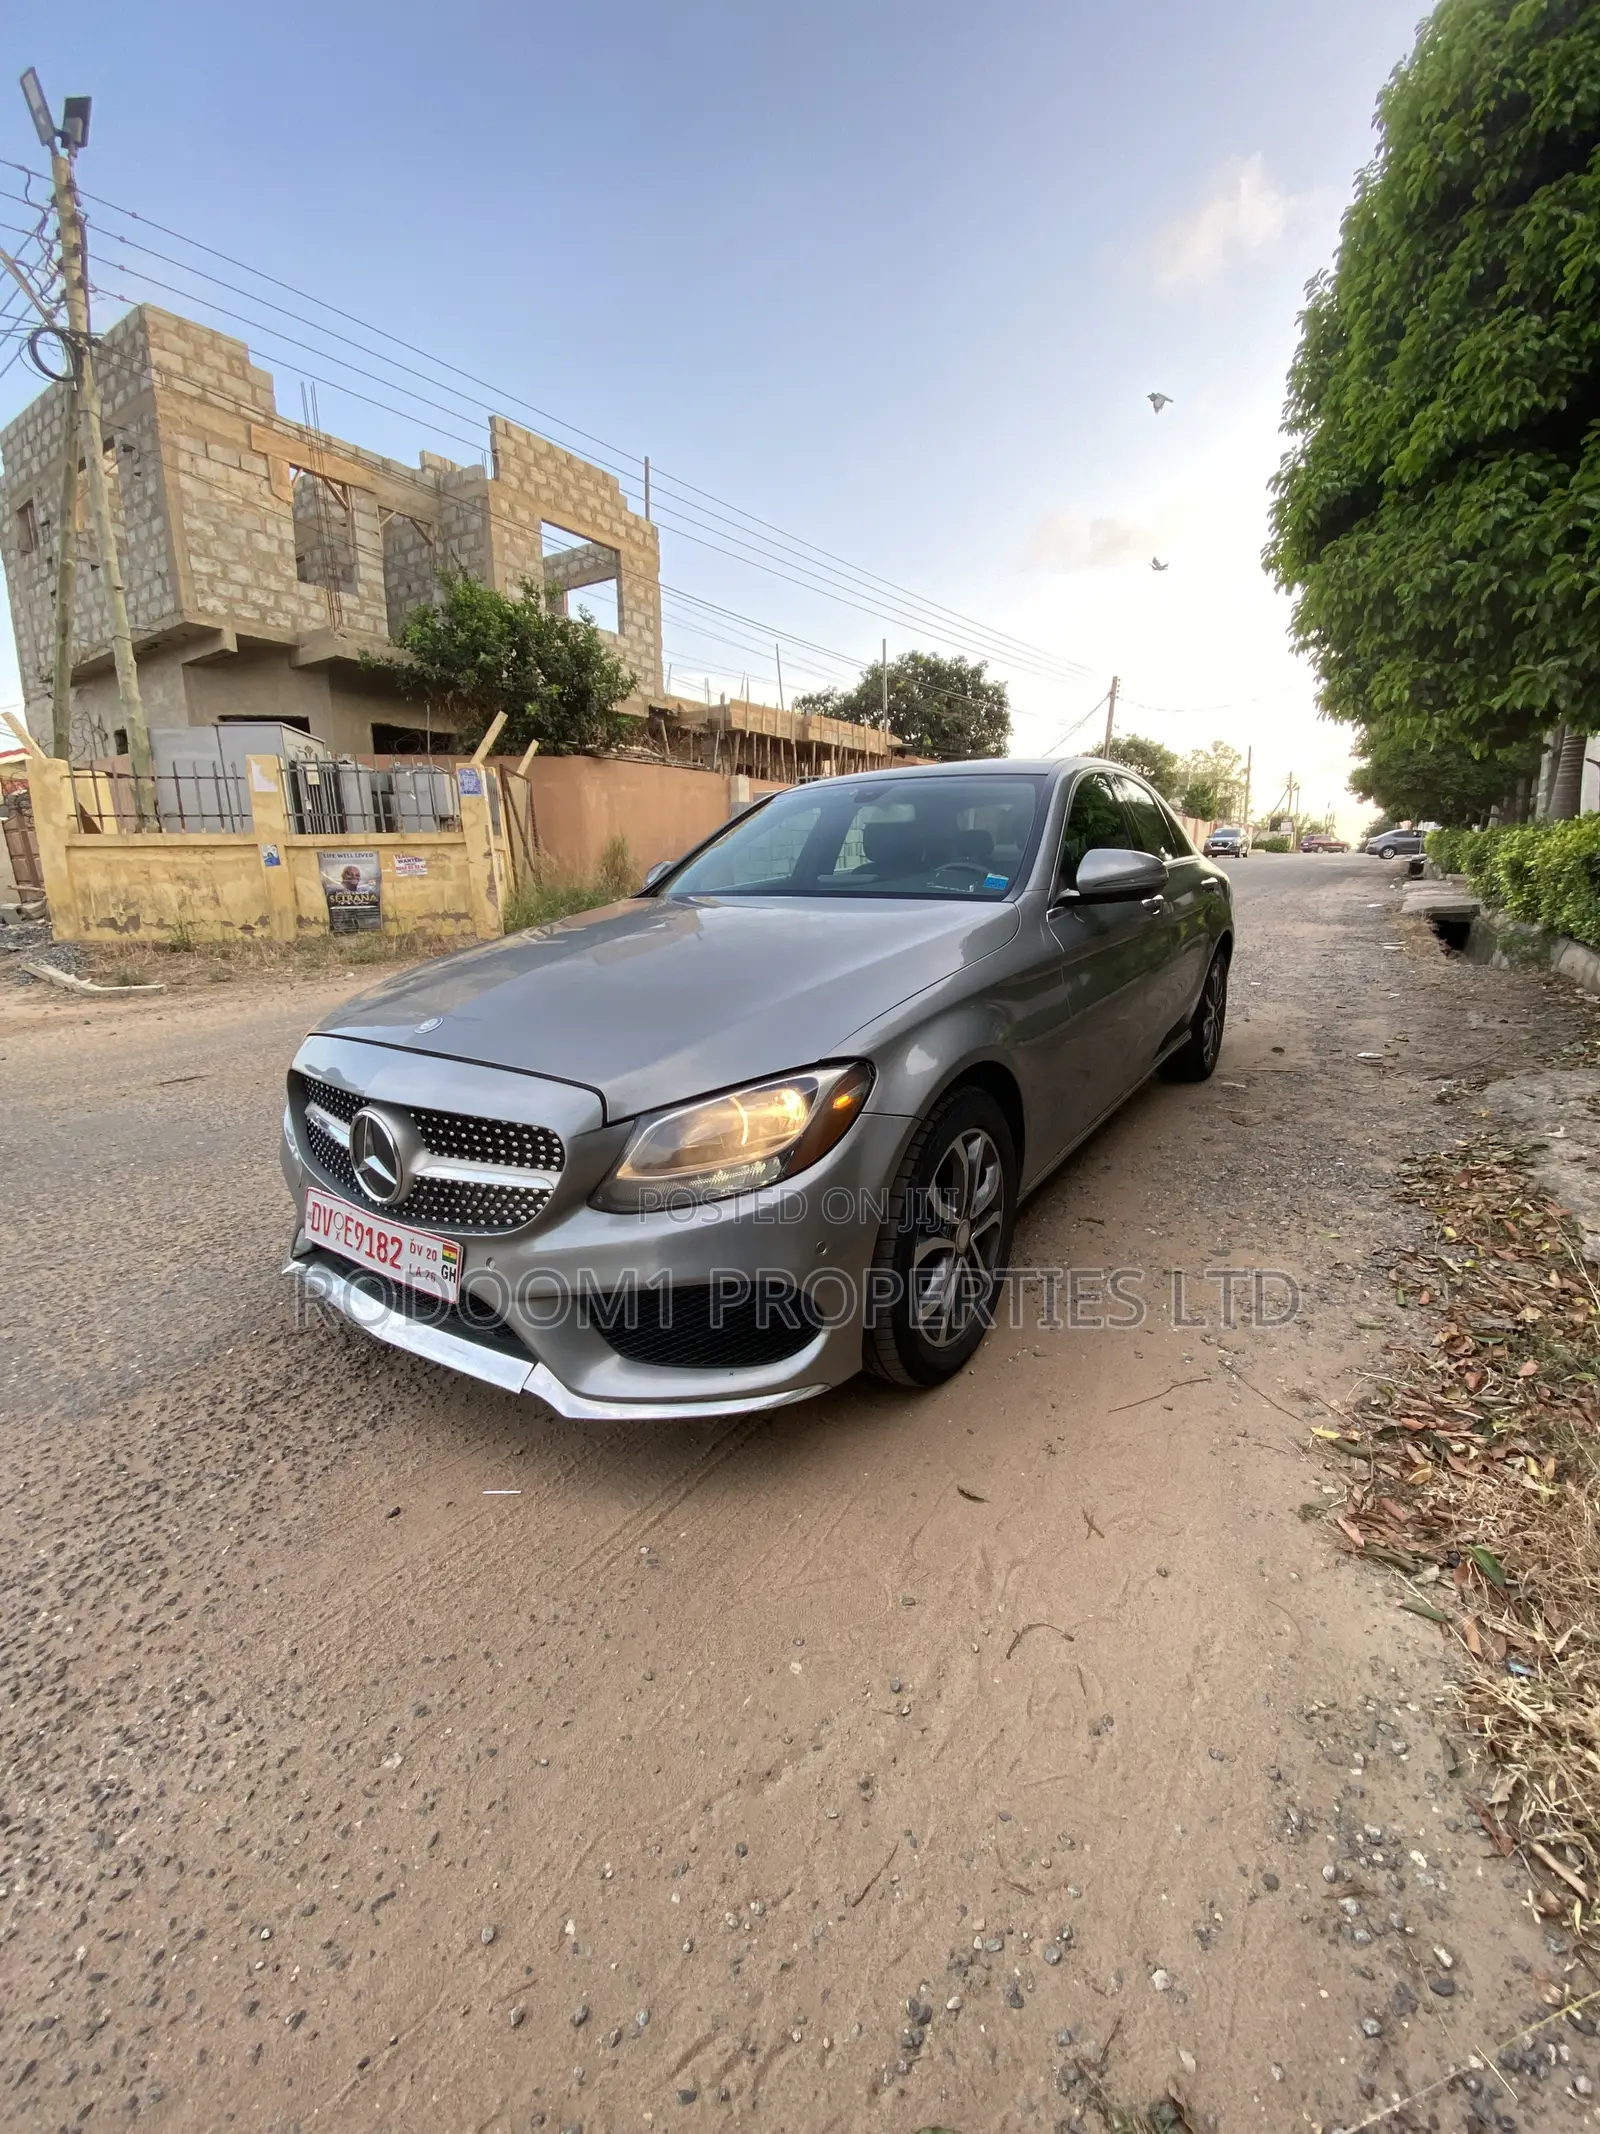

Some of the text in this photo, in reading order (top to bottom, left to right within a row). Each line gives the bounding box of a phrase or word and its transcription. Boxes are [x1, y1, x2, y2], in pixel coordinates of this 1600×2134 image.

[410, 1241, 438, 1262] DV 20
[441, 1264, 457, 1284] GH
